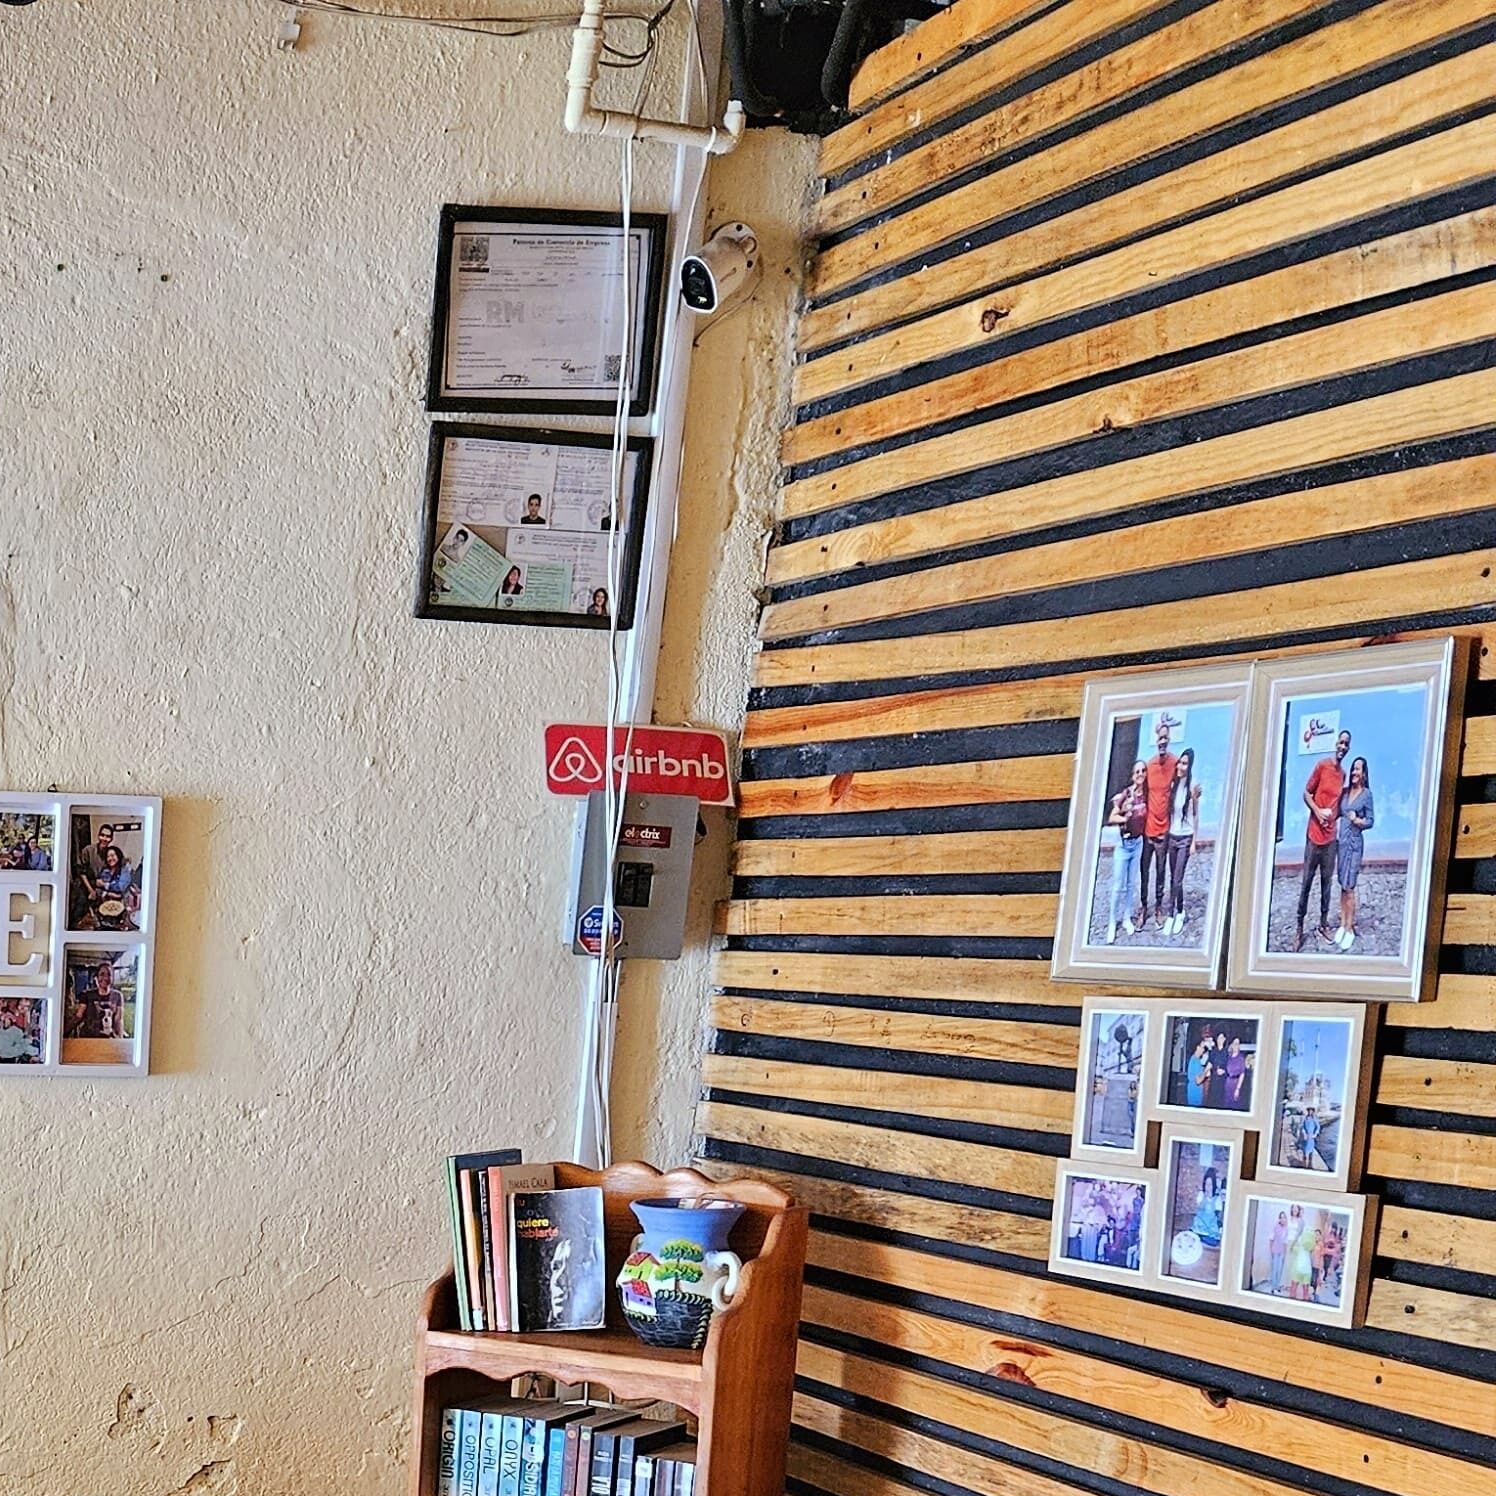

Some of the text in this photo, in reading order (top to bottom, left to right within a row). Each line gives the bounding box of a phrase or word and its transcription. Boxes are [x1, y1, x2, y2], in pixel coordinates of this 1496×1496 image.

[613, 748, 725, 780] airbnb
[440, 1430, 456, 1478] ORIGIN
[482, 1436, 497, 1474] OPAL
[502, 1439, 518, 1479] ONYX
[590, 1475, 610, 1494] OLA
